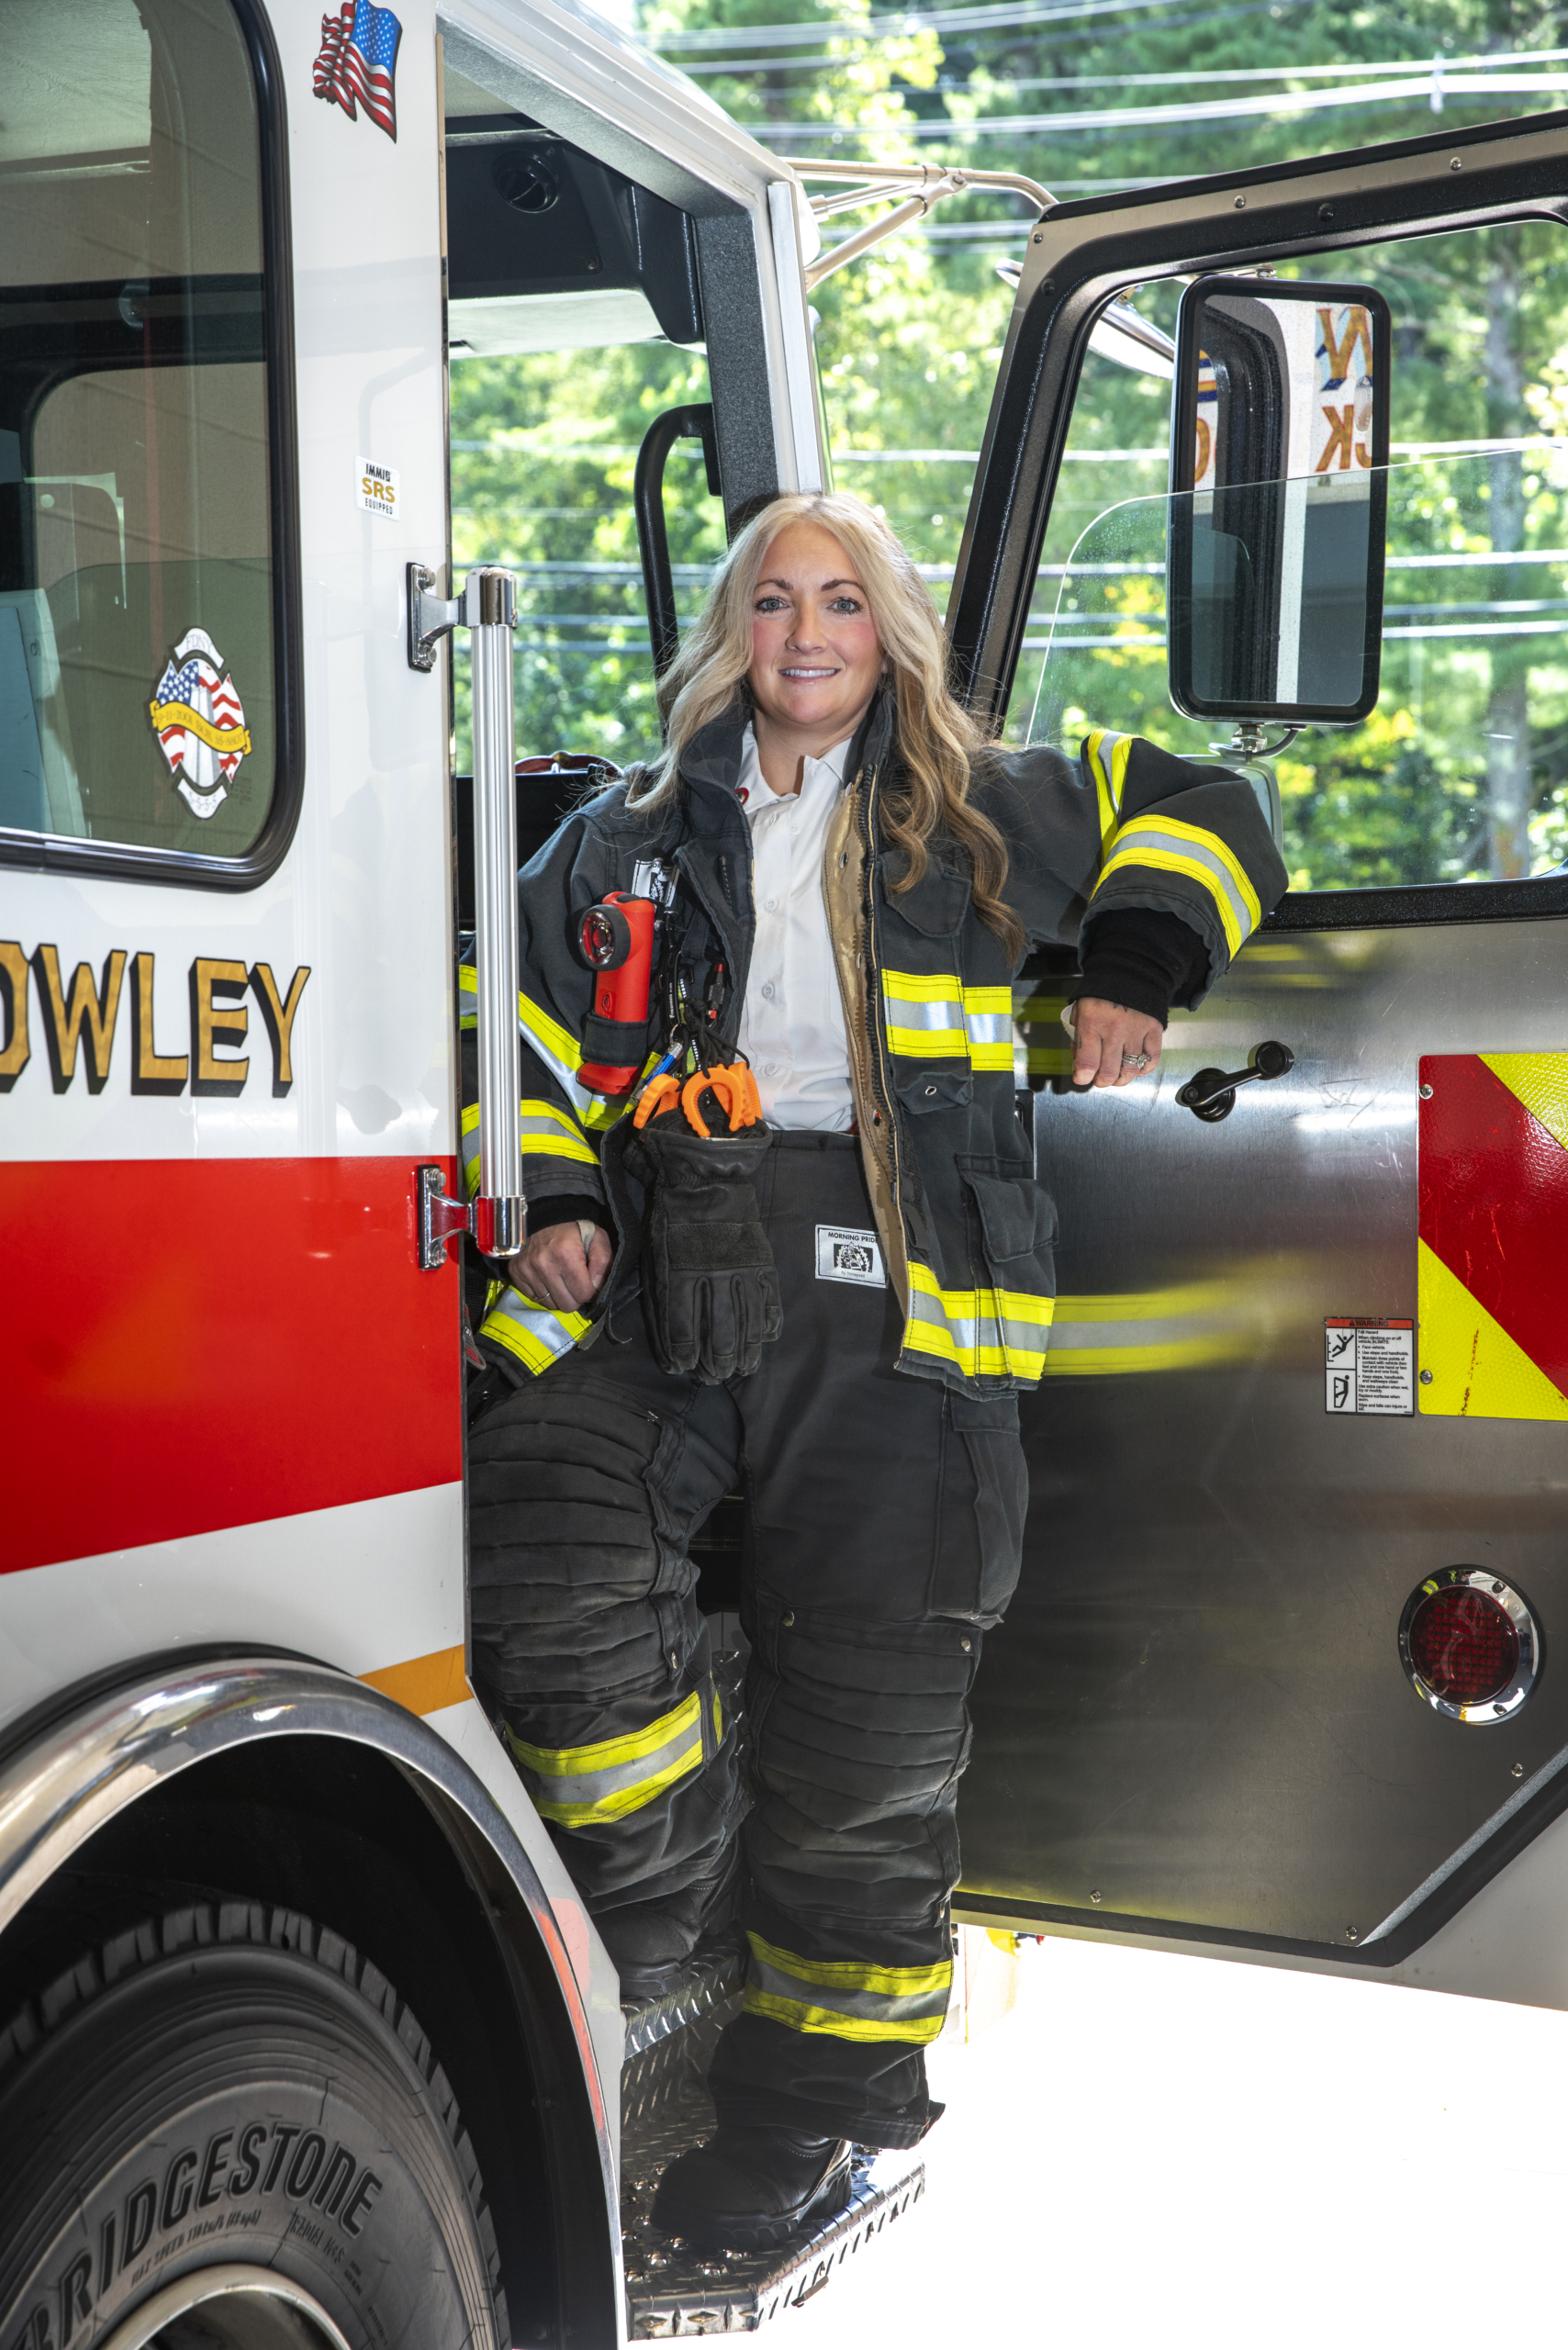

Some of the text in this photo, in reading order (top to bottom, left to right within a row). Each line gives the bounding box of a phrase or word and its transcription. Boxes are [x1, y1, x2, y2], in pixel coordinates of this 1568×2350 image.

[362, 477, 395, 503] SRS
[365, 498, 393, 515] EQUIPPED
[185, 634, 214, 655] FDNY
[828, 1232, 859, 1241] MORNING
